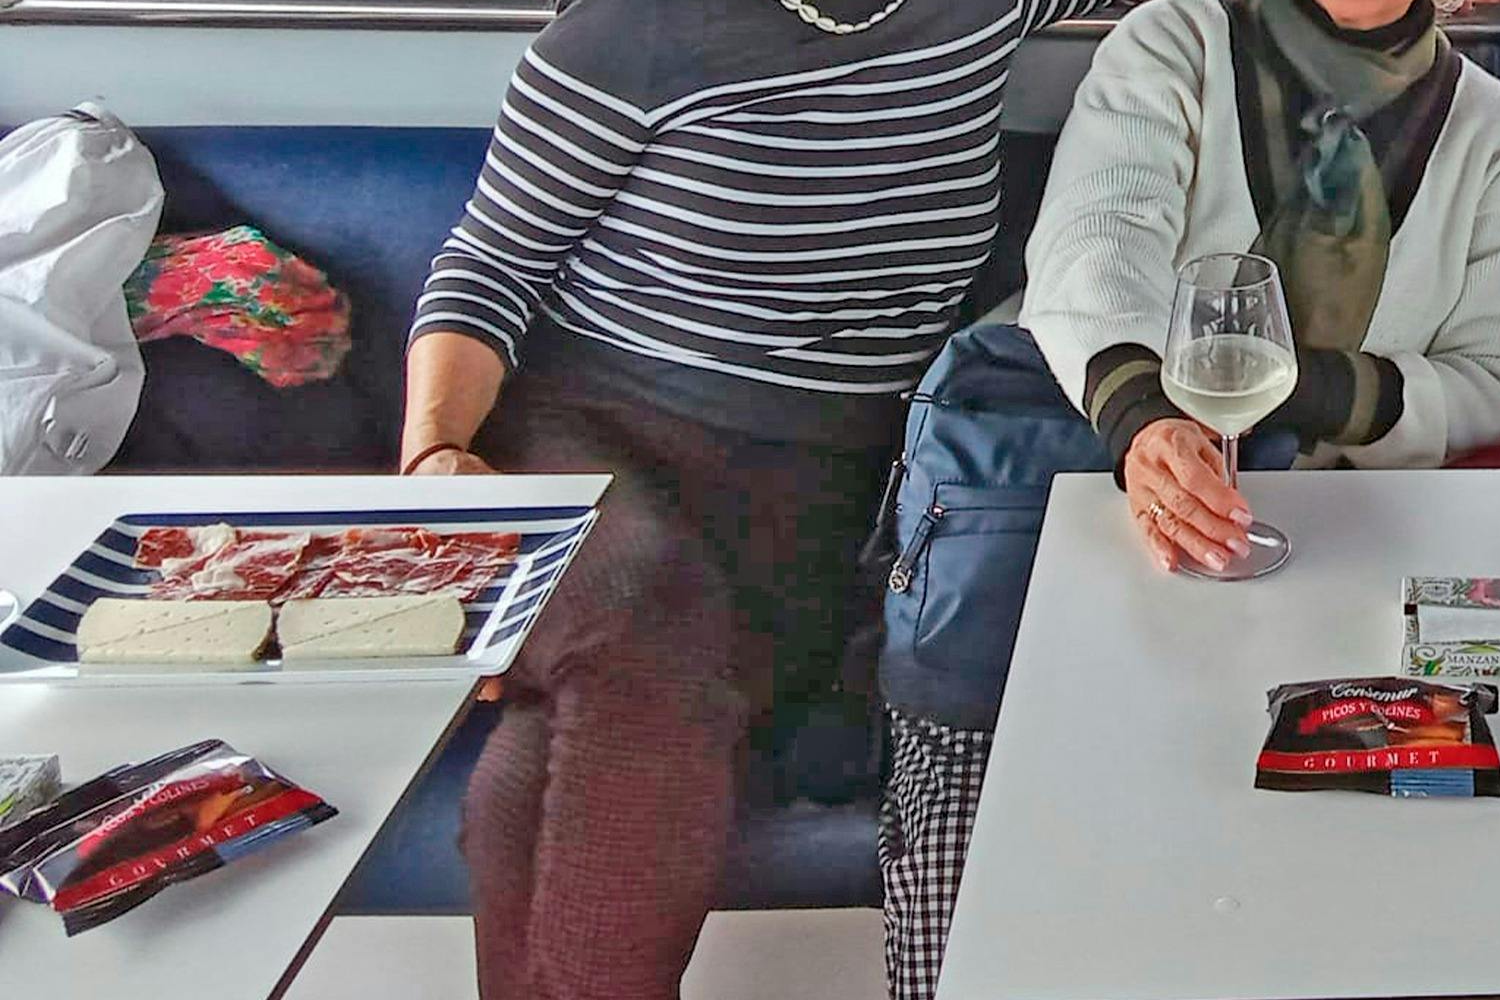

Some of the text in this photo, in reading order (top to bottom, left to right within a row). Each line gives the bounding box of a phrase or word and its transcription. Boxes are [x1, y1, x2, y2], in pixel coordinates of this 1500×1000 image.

[1322, 703, 1355, 721] PICOS
[1359, 702, 1368, 712] Y
[1304, 751, 1439, 768] GOURMET
